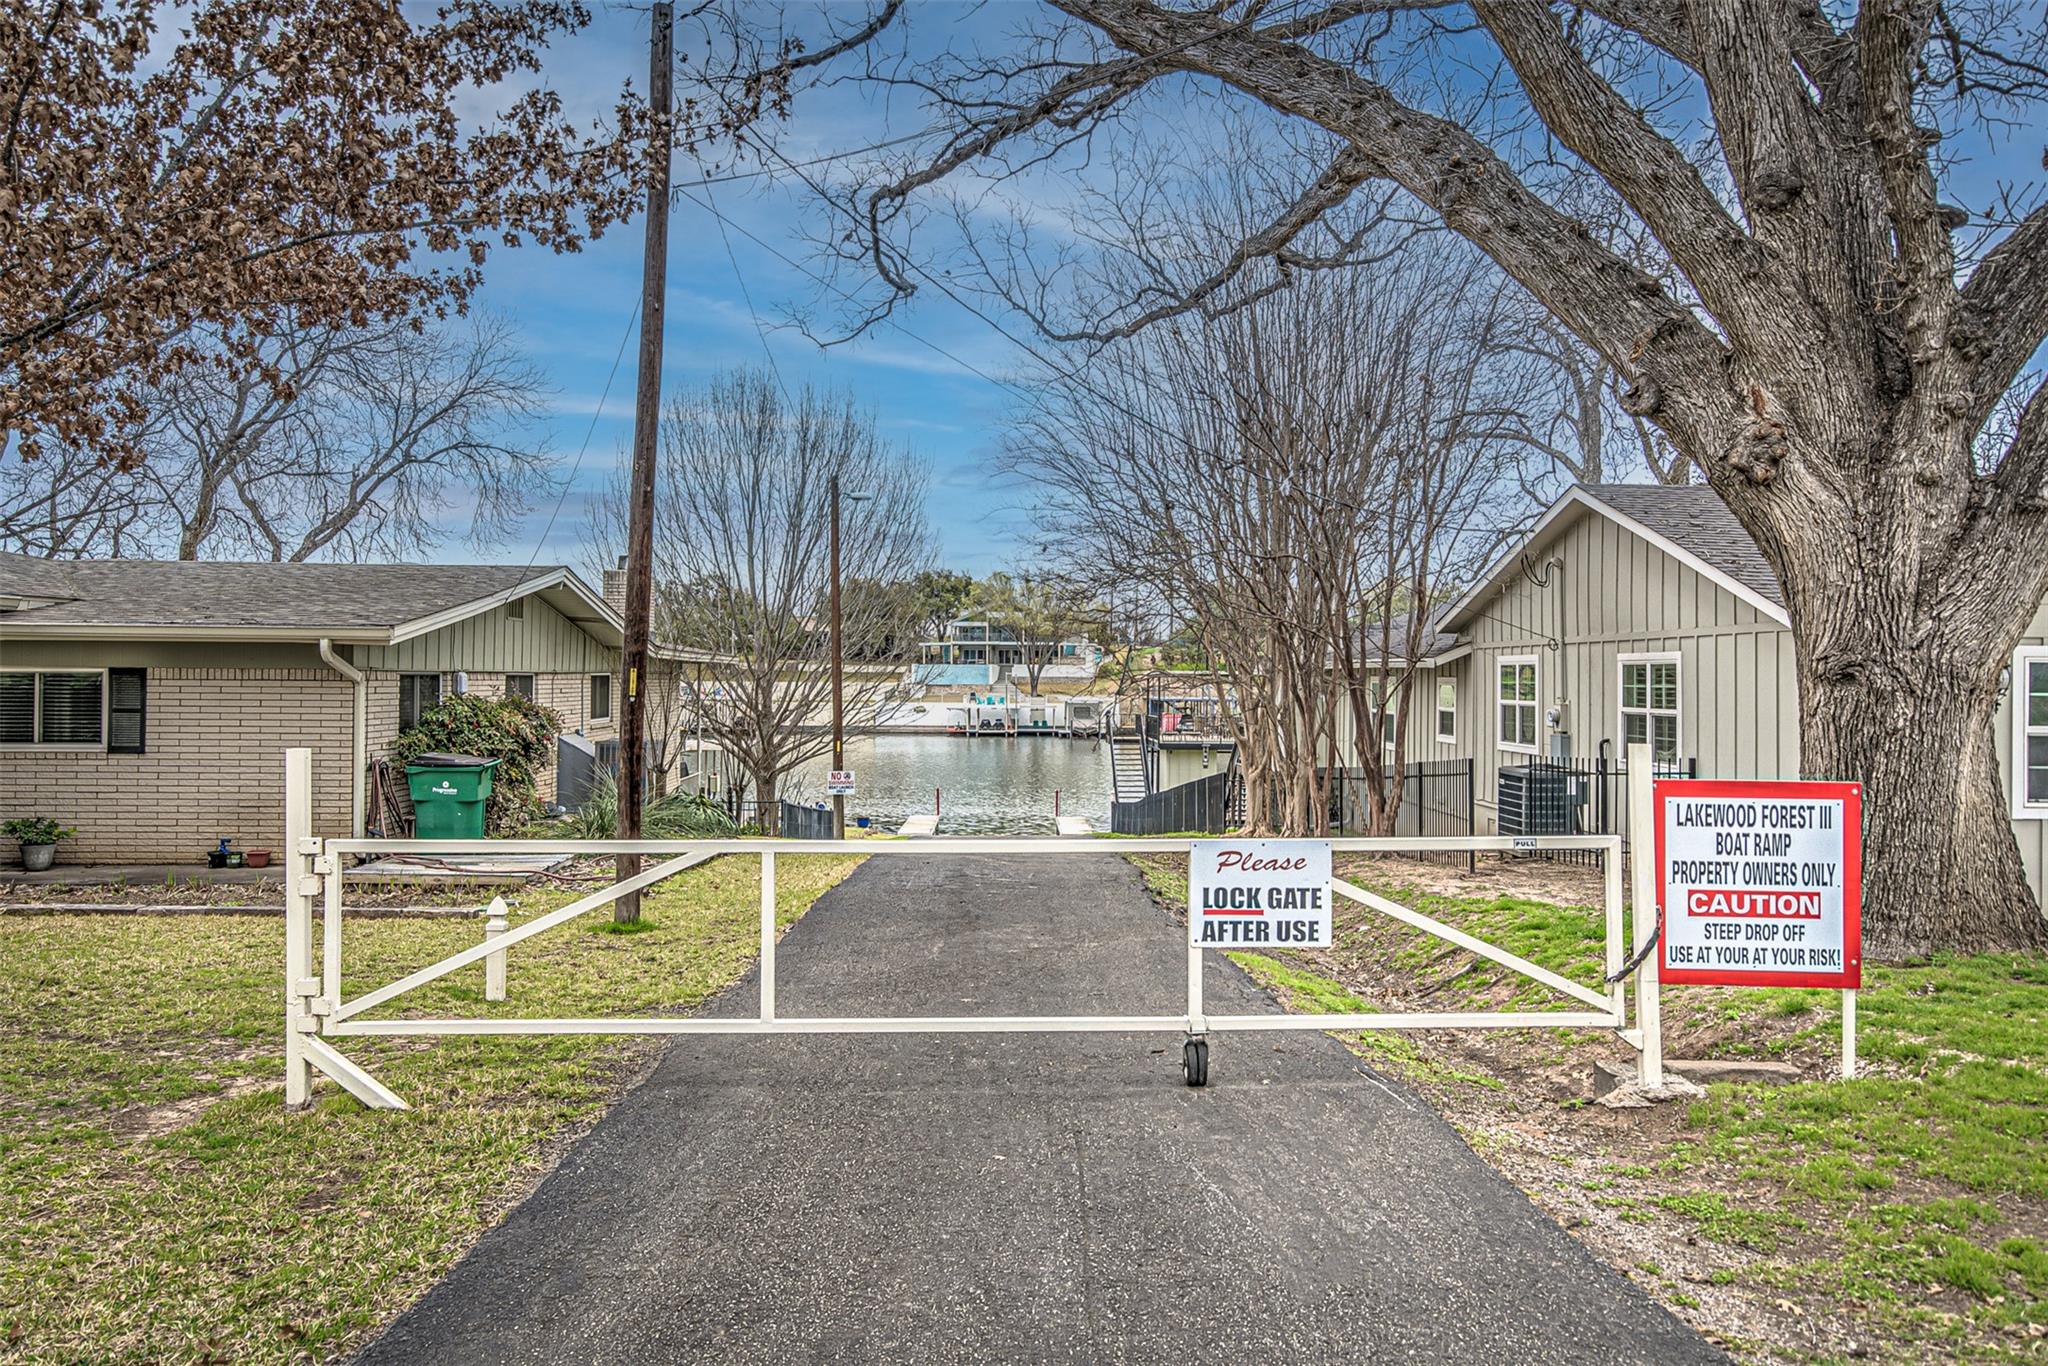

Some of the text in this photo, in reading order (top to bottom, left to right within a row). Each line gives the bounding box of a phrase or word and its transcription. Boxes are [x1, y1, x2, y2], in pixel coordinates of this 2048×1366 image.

[831, 772, 842, 780] NO
[1676, 803, 1832, 830] LAKEWOOD FOREST III
[1715, 832, 1792, 857] BOAT RAMP
[1216, 850, 1307, 874] Please
[1672, 860, 1836, 887] PROPERTY OWNERS ONLY
[1202, 887, 1322, 910] LOCK GATE
[1689, 893, 1820, 916] CAUTION
[1201, 920, 1319, 942] AFTER USE
[1704, 923, 1805, 942] STEEP DROP OFF
[1669, 946, 1841, 967] USE AT YOUR AT YOUR RISK!
